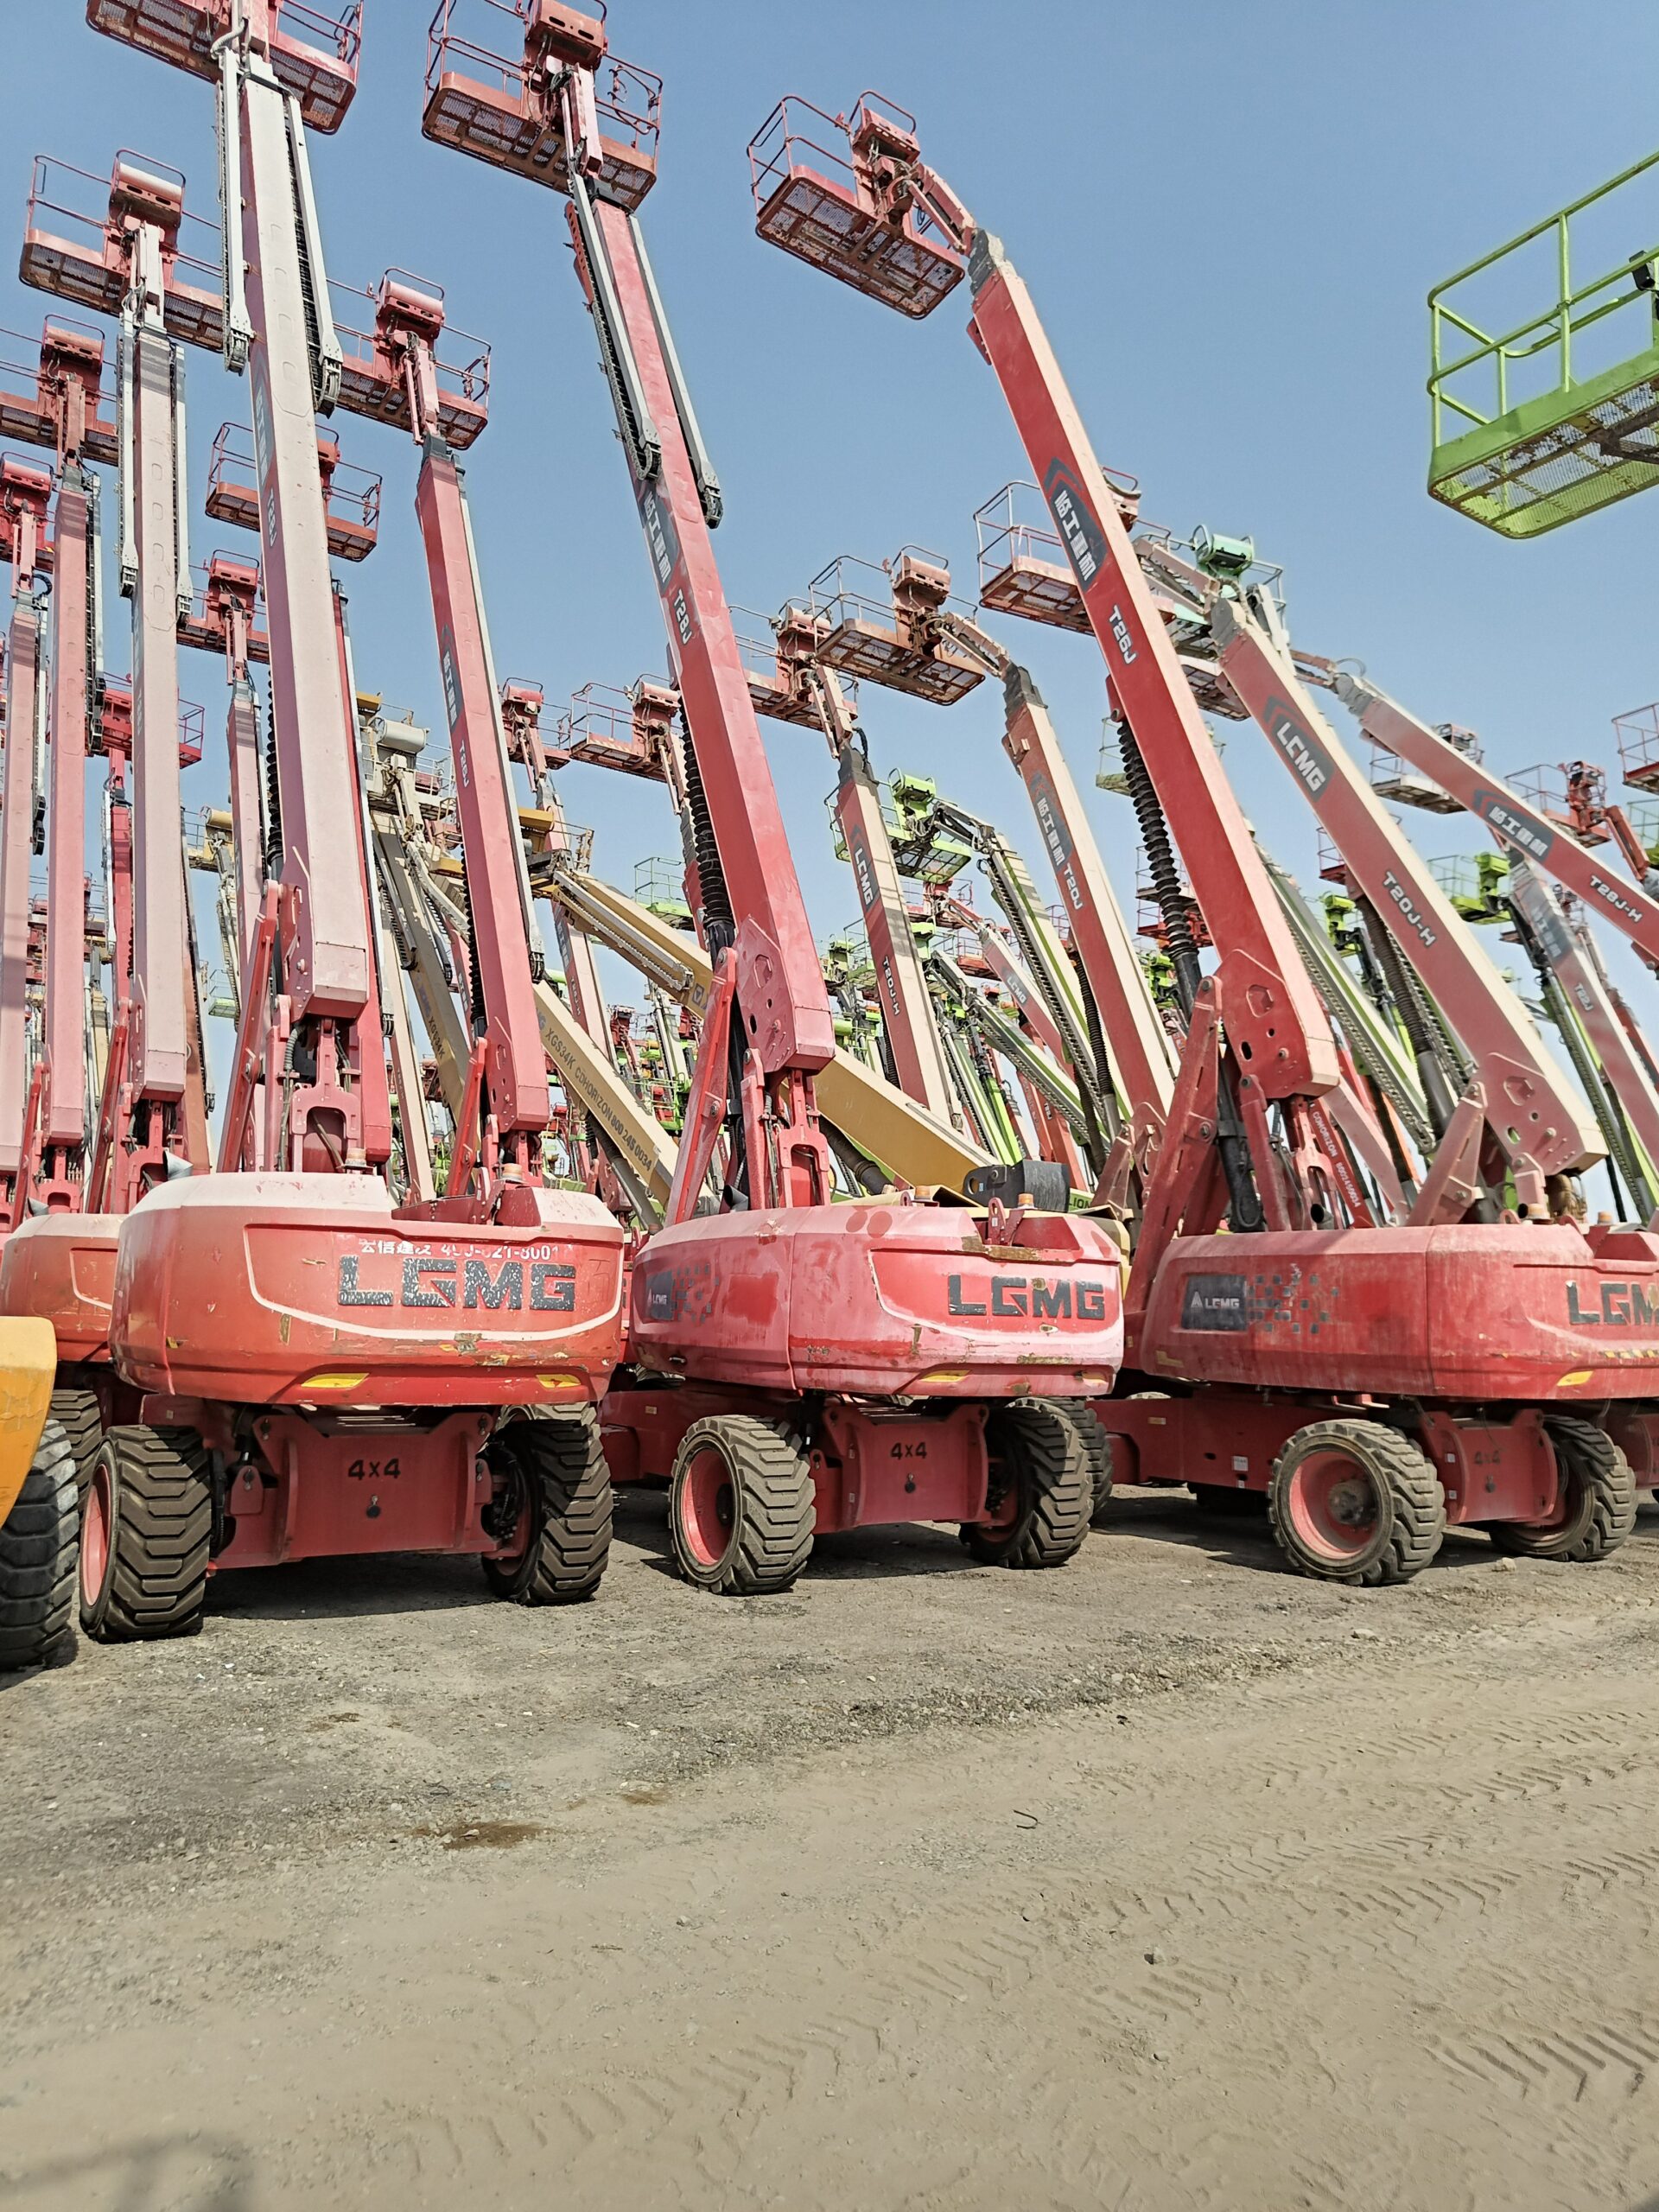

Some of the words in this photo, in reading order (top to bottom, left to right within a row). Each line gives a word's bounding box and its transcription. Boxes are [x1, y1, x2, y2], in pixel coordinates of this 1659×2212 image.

[1054, 490, 1096, 581] 临工重机
[672, 588, 692, 645] T28J
[1109, 605, 1137, 664] T26J
[1276, 721, 1325, 792] LGMG
[855, 848, 873, 906] LGMG
[1064, 862, 1083, 910] T20J
[1590, 874, 1643, 923] T28J-H
[1383, 871, 1437, 947] T20J-H
[545, 1027, 576, 1070] XGS34K
[575, 1067, 613, 1121] CDHORIZON
[611, 1114, 625, 1135] 800
[622, 1129, 636, 1151] 245
[634, 1145, 652, 1172] 0034
[337, 1255, 575, 1311] LGMG
[947, 1274, 1105, 1320] LGMG
[1205, 1298, 1240, 1309] LGMG
[347, 1459, 401, 1480] 4x4
[890, 1441, 927, 1459] 4x4
